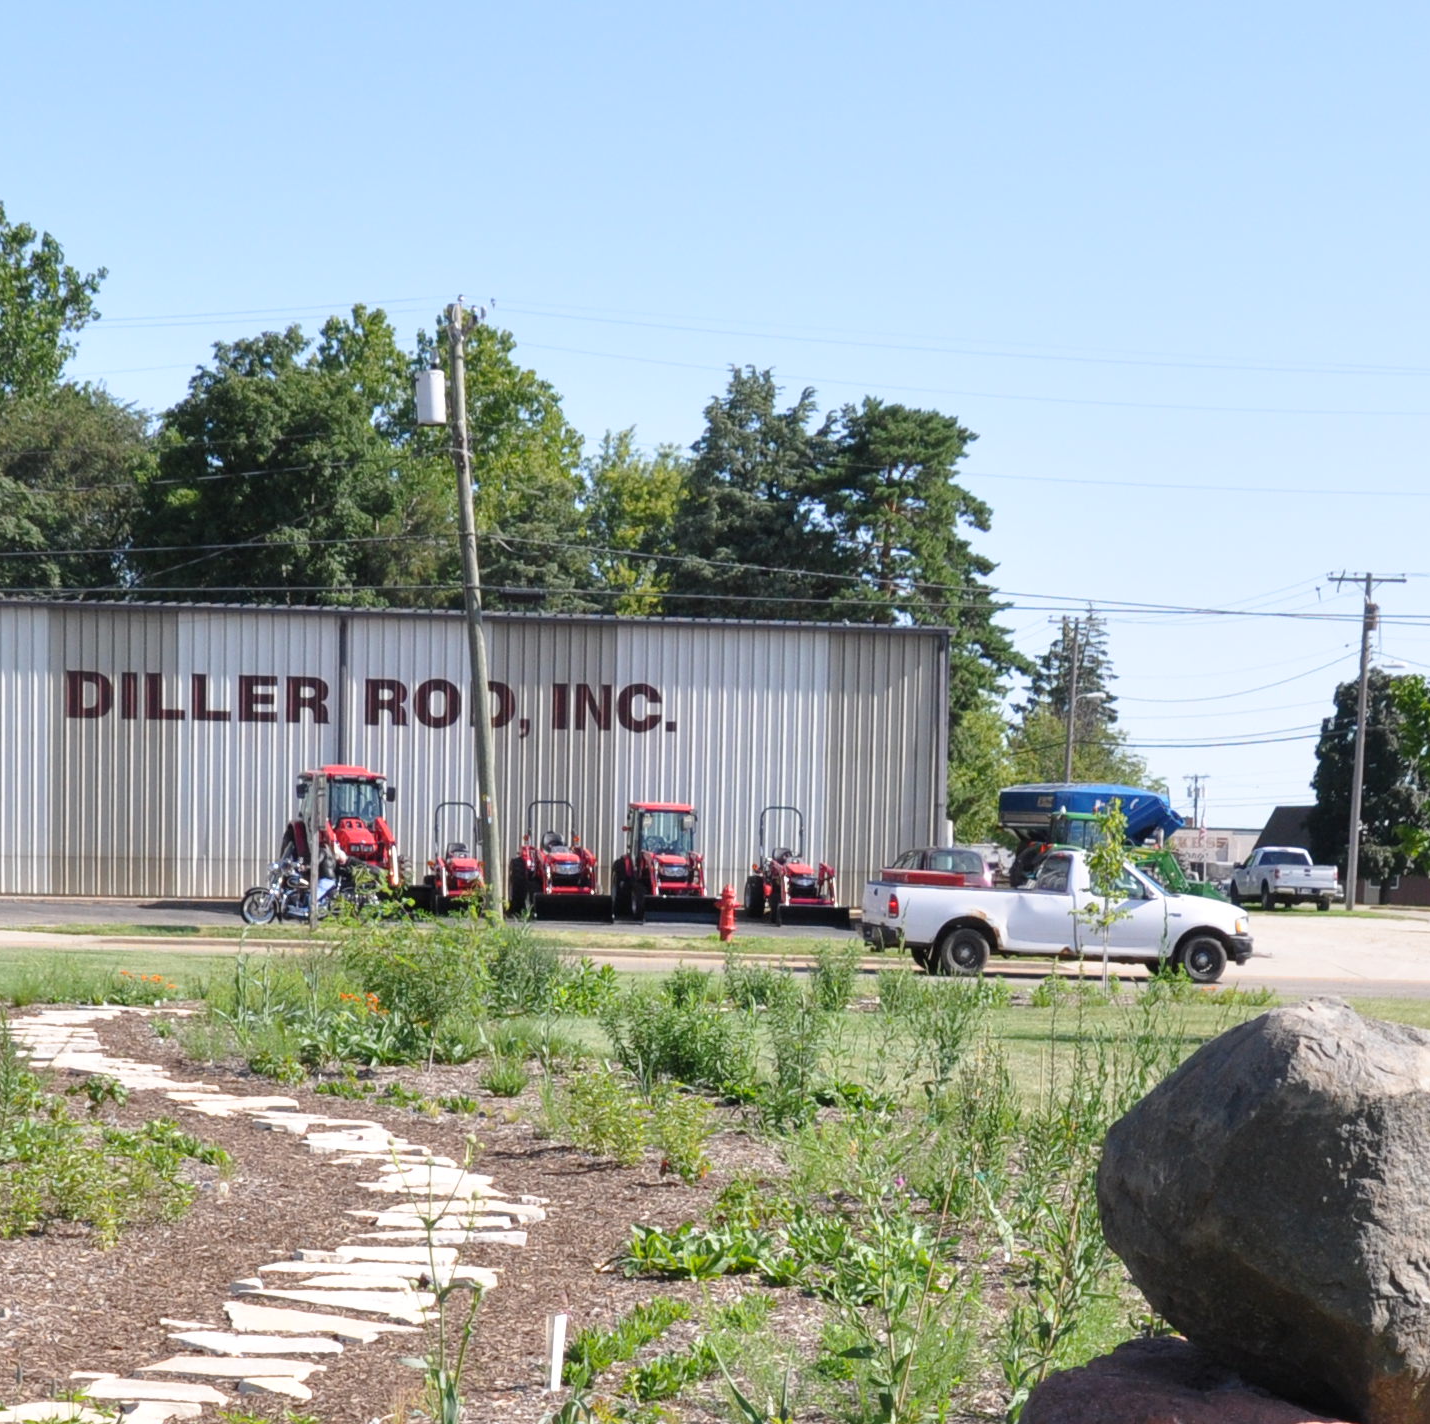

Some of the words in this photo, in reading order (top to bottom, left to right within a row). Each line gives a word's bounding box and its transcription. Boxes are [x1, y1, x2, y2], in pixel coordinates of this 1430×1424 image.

[66, 670, 330, 724] DILLER
[364, 679, 531, 739] ROD,
[551, 683, 677, 733] INC.
